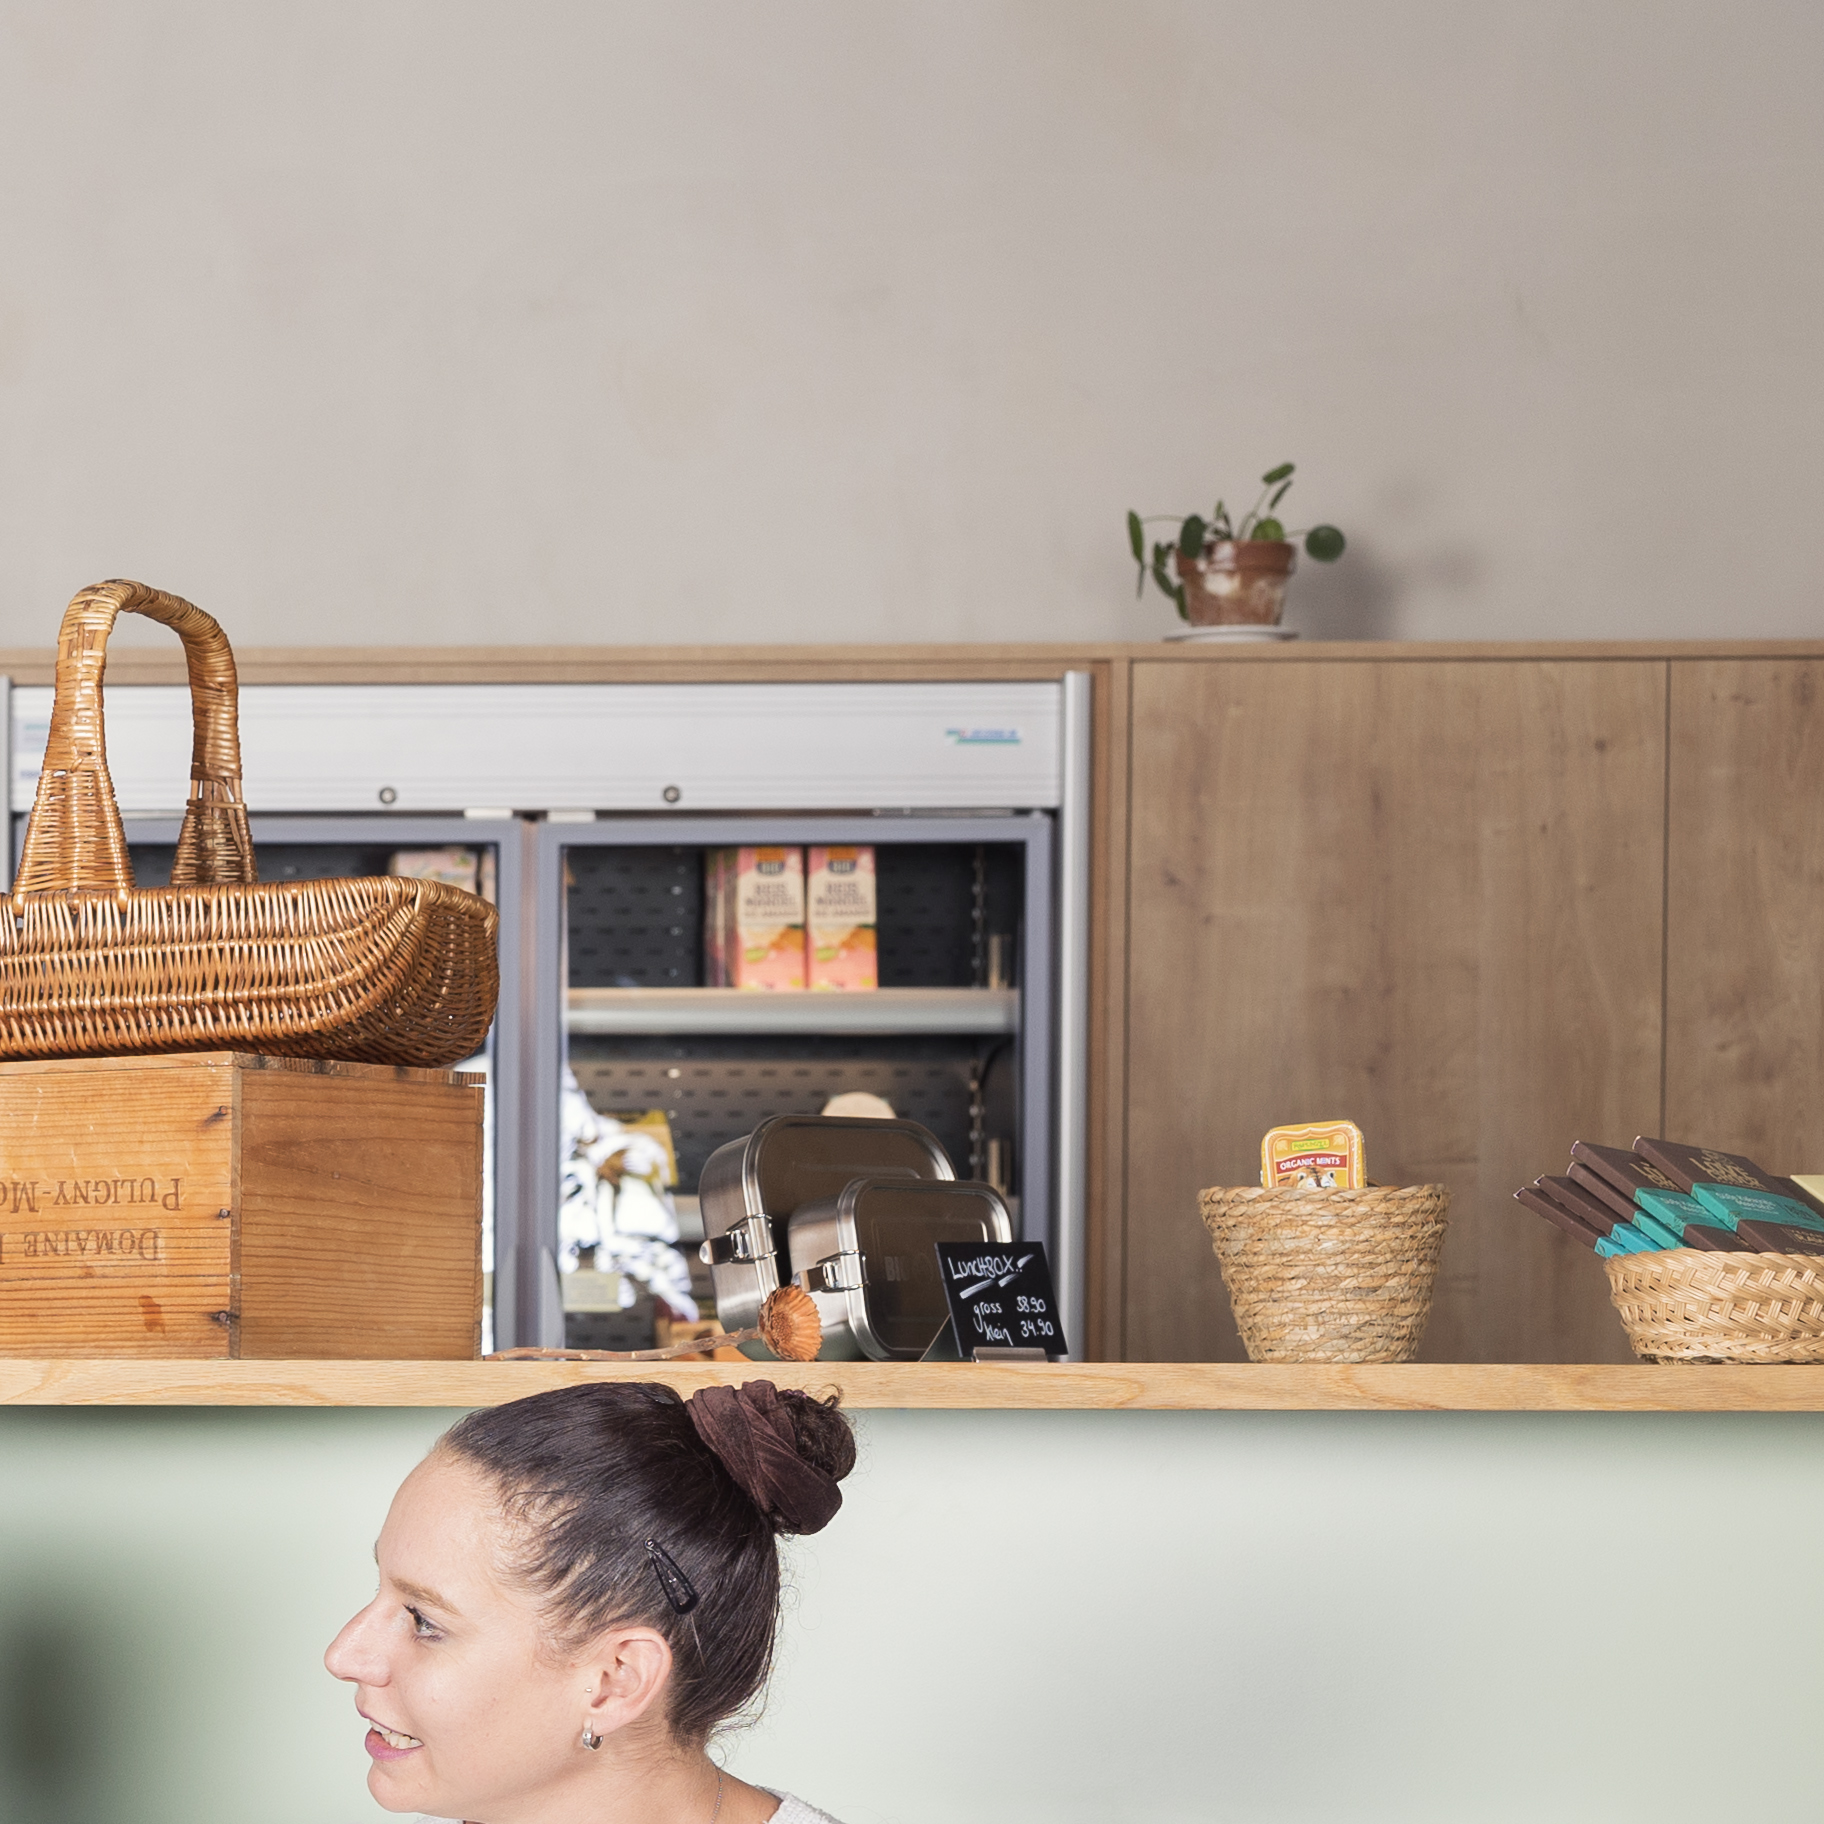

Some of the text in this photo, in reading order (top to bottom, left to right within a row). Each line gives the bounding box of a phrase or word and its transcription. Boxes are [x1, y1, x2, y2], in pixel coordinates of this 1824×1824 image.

[1280, 1157, 1340, 1171] ORGANIC MINTS
[23, 1229, 163, 1261] DOMAINE
[1020, 1318, 1054, 1338] 34.90
